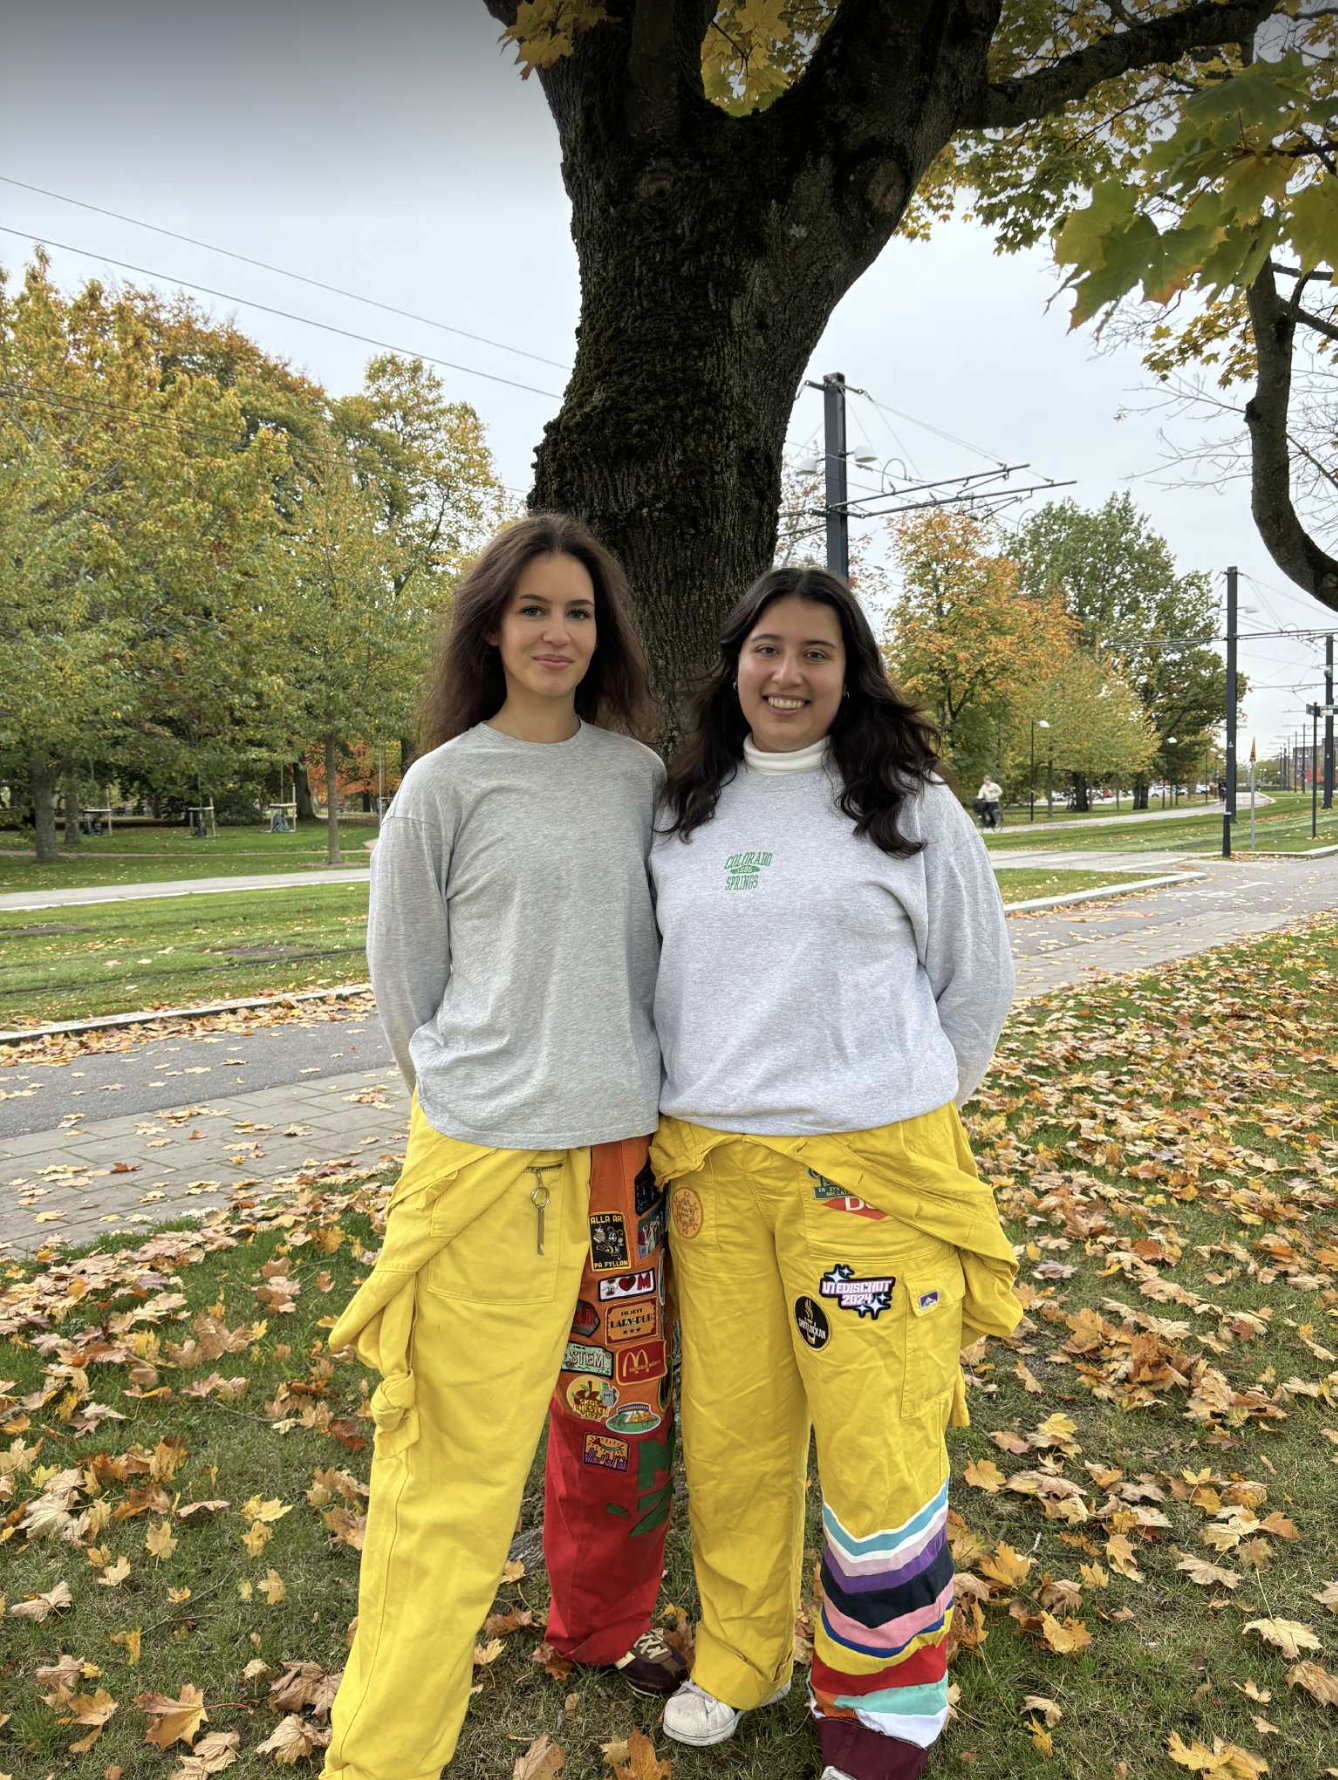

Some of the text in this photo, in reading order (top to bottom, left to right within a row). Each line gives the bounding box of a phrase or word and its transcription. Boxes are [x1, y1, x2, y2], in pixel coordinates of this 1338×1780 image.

[724, 851, 773, 869] COLORADO
[725, 875, 759, 891] SPRINGS
[590, 1215, 611, 1225] ALLA
[840, 1293, 872, 1306] 2024
